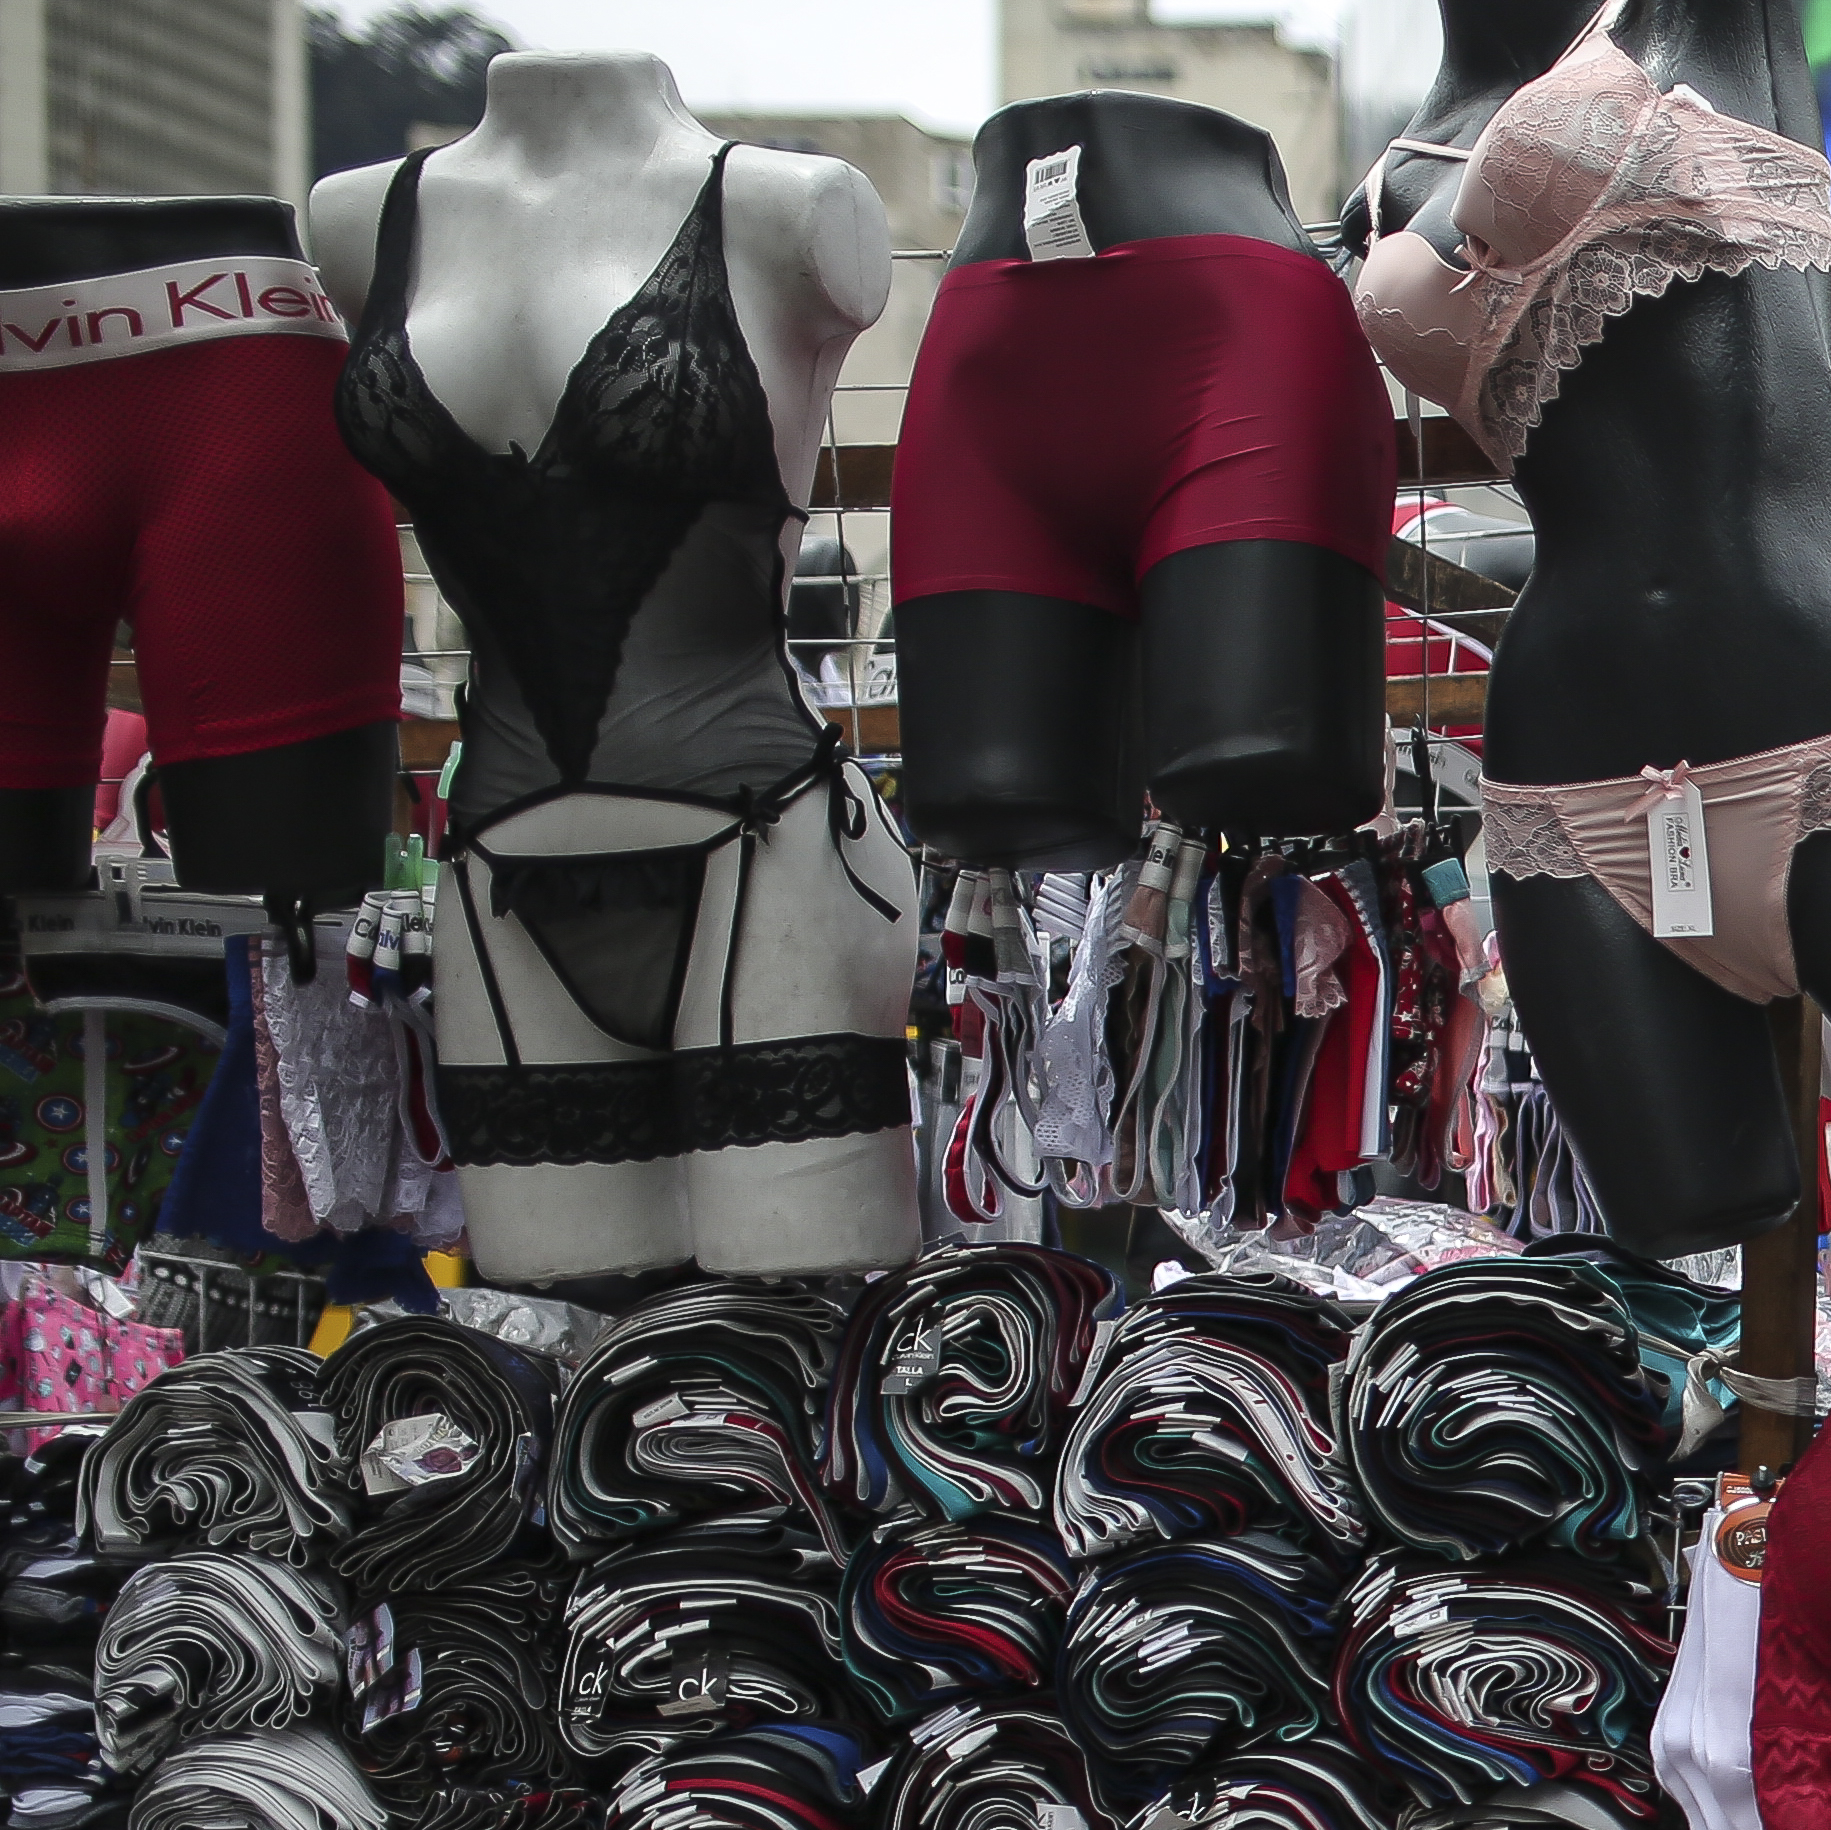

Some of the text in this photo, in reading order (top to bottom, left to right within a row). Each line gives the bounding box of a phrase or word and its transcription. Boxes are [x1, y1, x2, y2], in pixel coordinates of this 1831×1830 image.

[0, 298, 144, 354] vin
[578, 1661, 609, 1695] ck
[678, 1667, 718, 1701] ck
